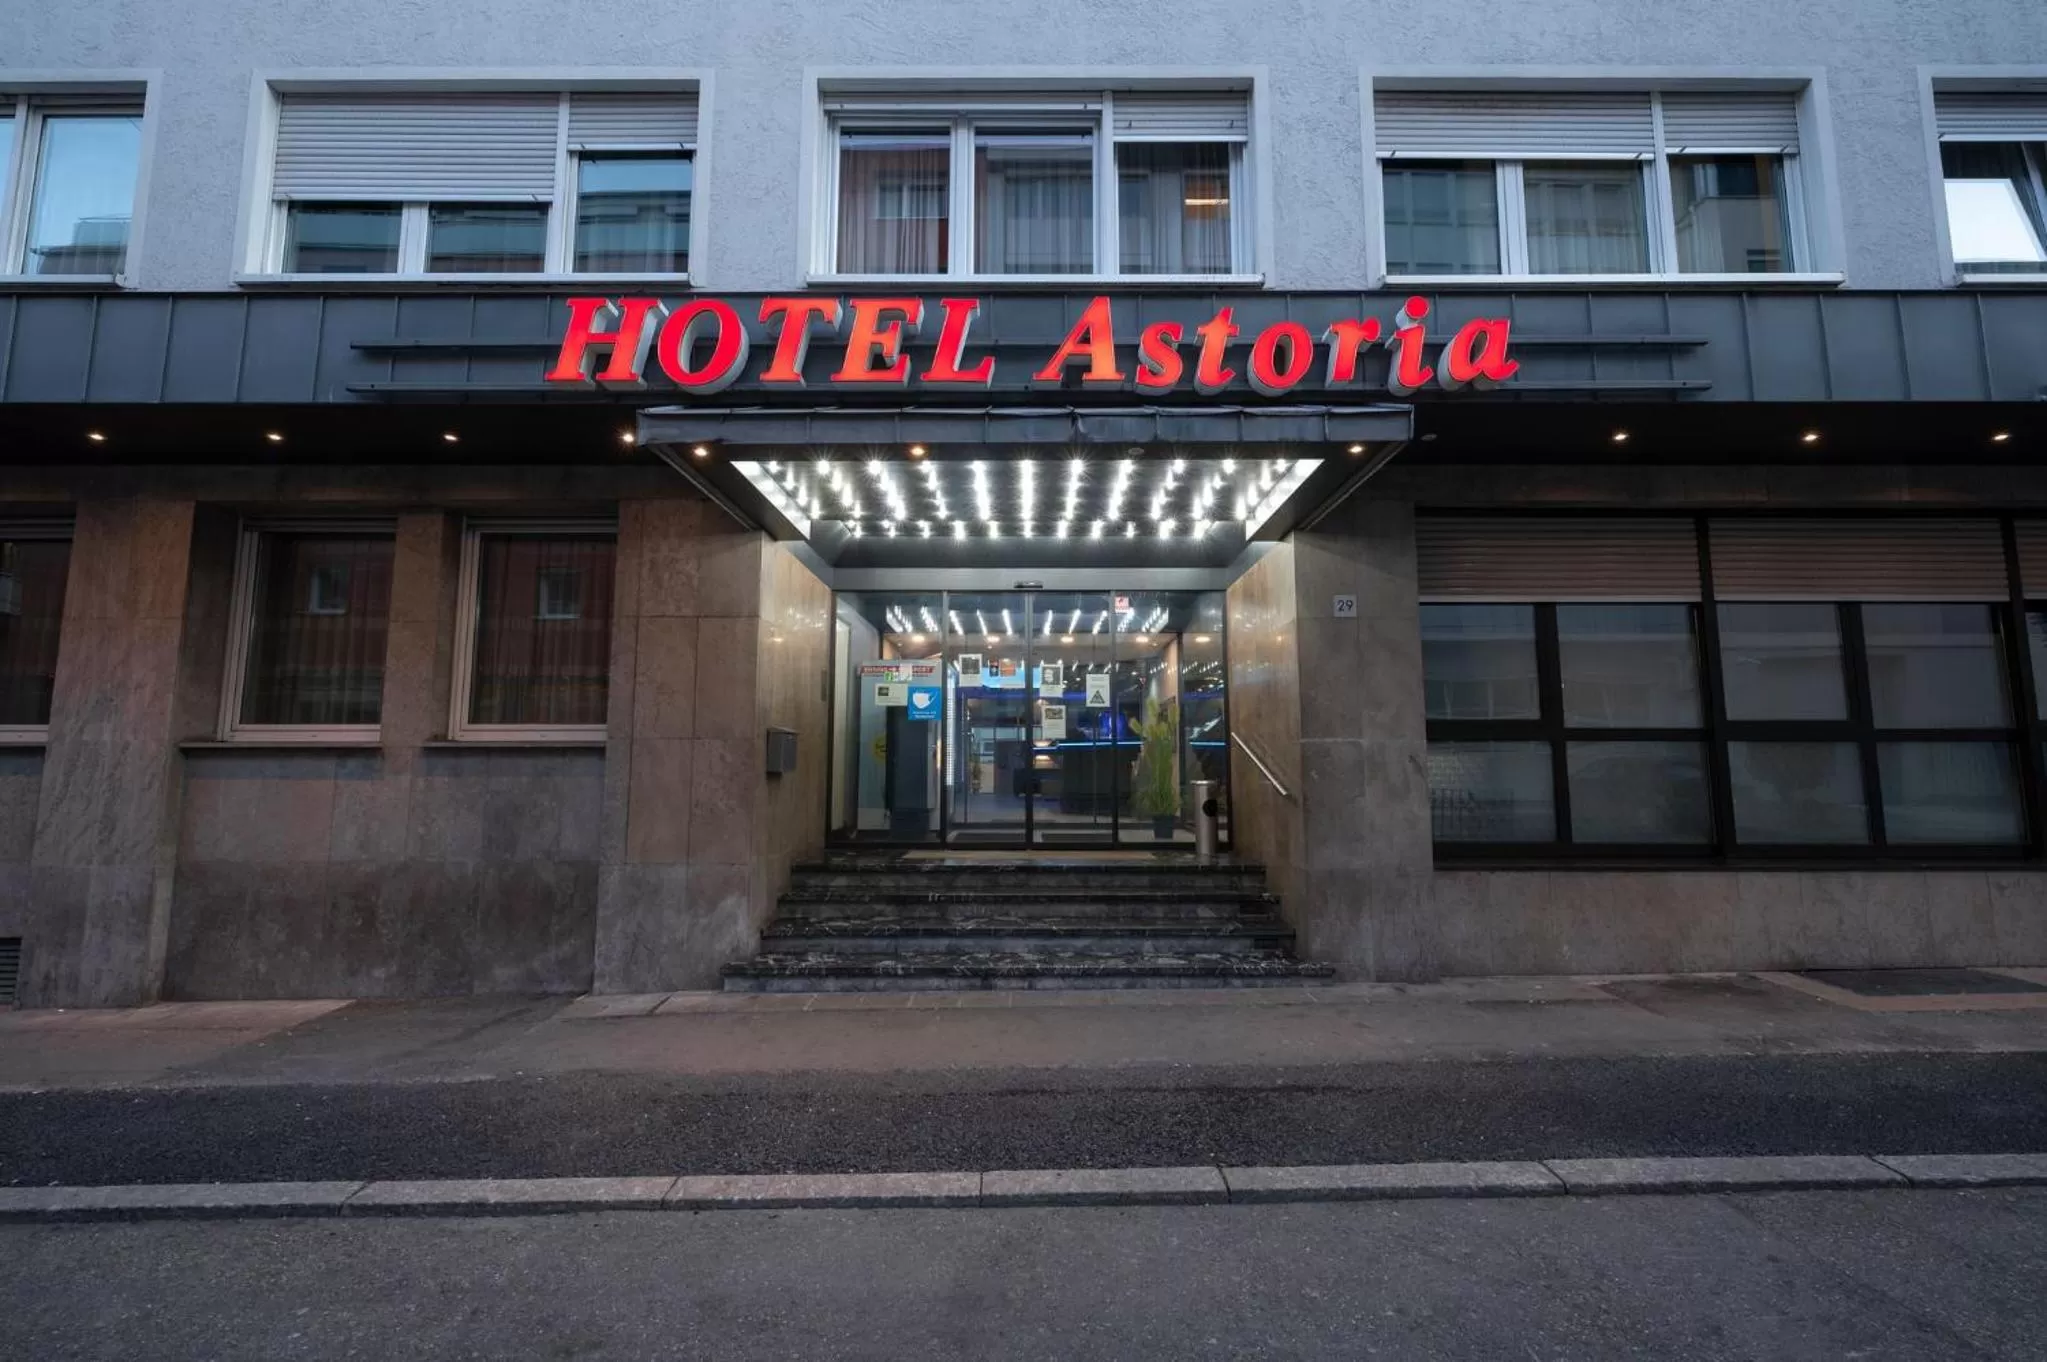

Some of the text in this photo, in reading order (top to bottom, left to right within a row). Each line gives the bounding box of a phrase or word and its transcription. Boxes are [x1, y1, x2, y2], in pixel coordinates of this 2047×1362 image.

[547, 296, 1519, 391] HOTEL Astoria
[1337, 599, 1354, 612] 29
